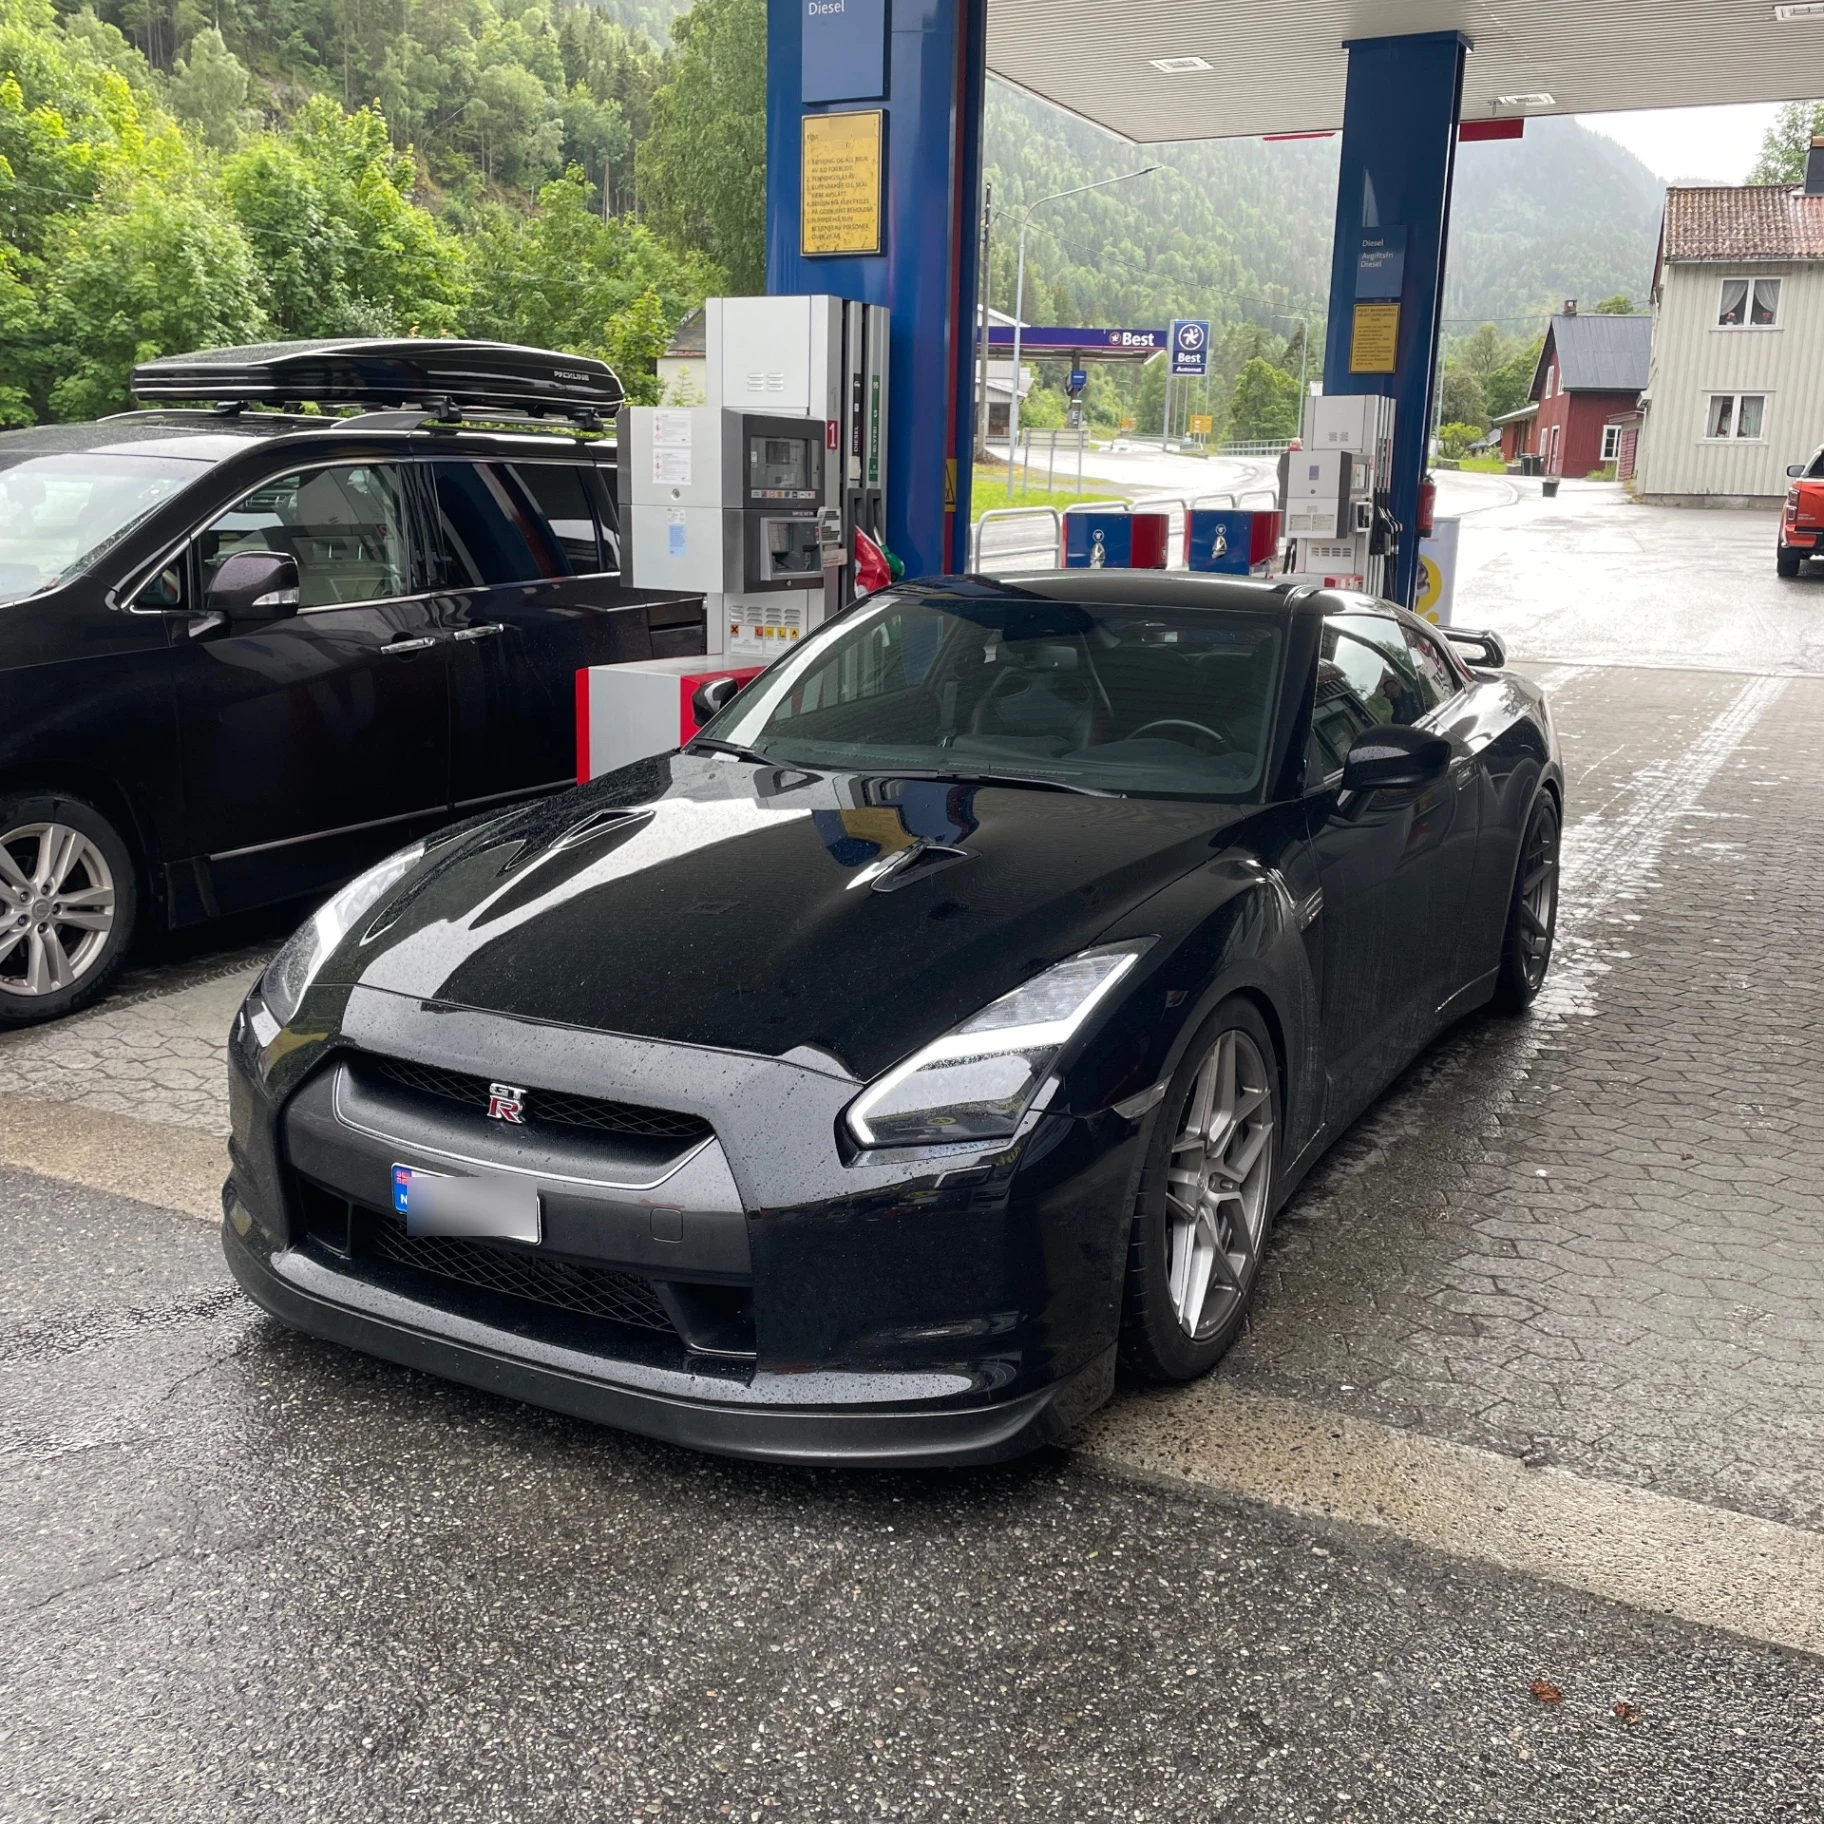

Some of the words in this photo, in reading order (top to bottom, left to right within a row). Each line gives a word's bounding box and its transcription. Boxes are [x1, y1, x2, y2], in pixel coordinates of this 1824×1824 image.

[808, 0, 845, 15] Diesel
[1362, 238, 1384, 247] Diesel
[1360, 260, 1382, 268] Diesel
[1122, 332, 1155, 347] Best
[1177, 352, 1201, 363] Best
[829, 422, 836, 448] 1
[489, 1082, 528, 1101] GT
[486, 1094, 523, 1124] R
